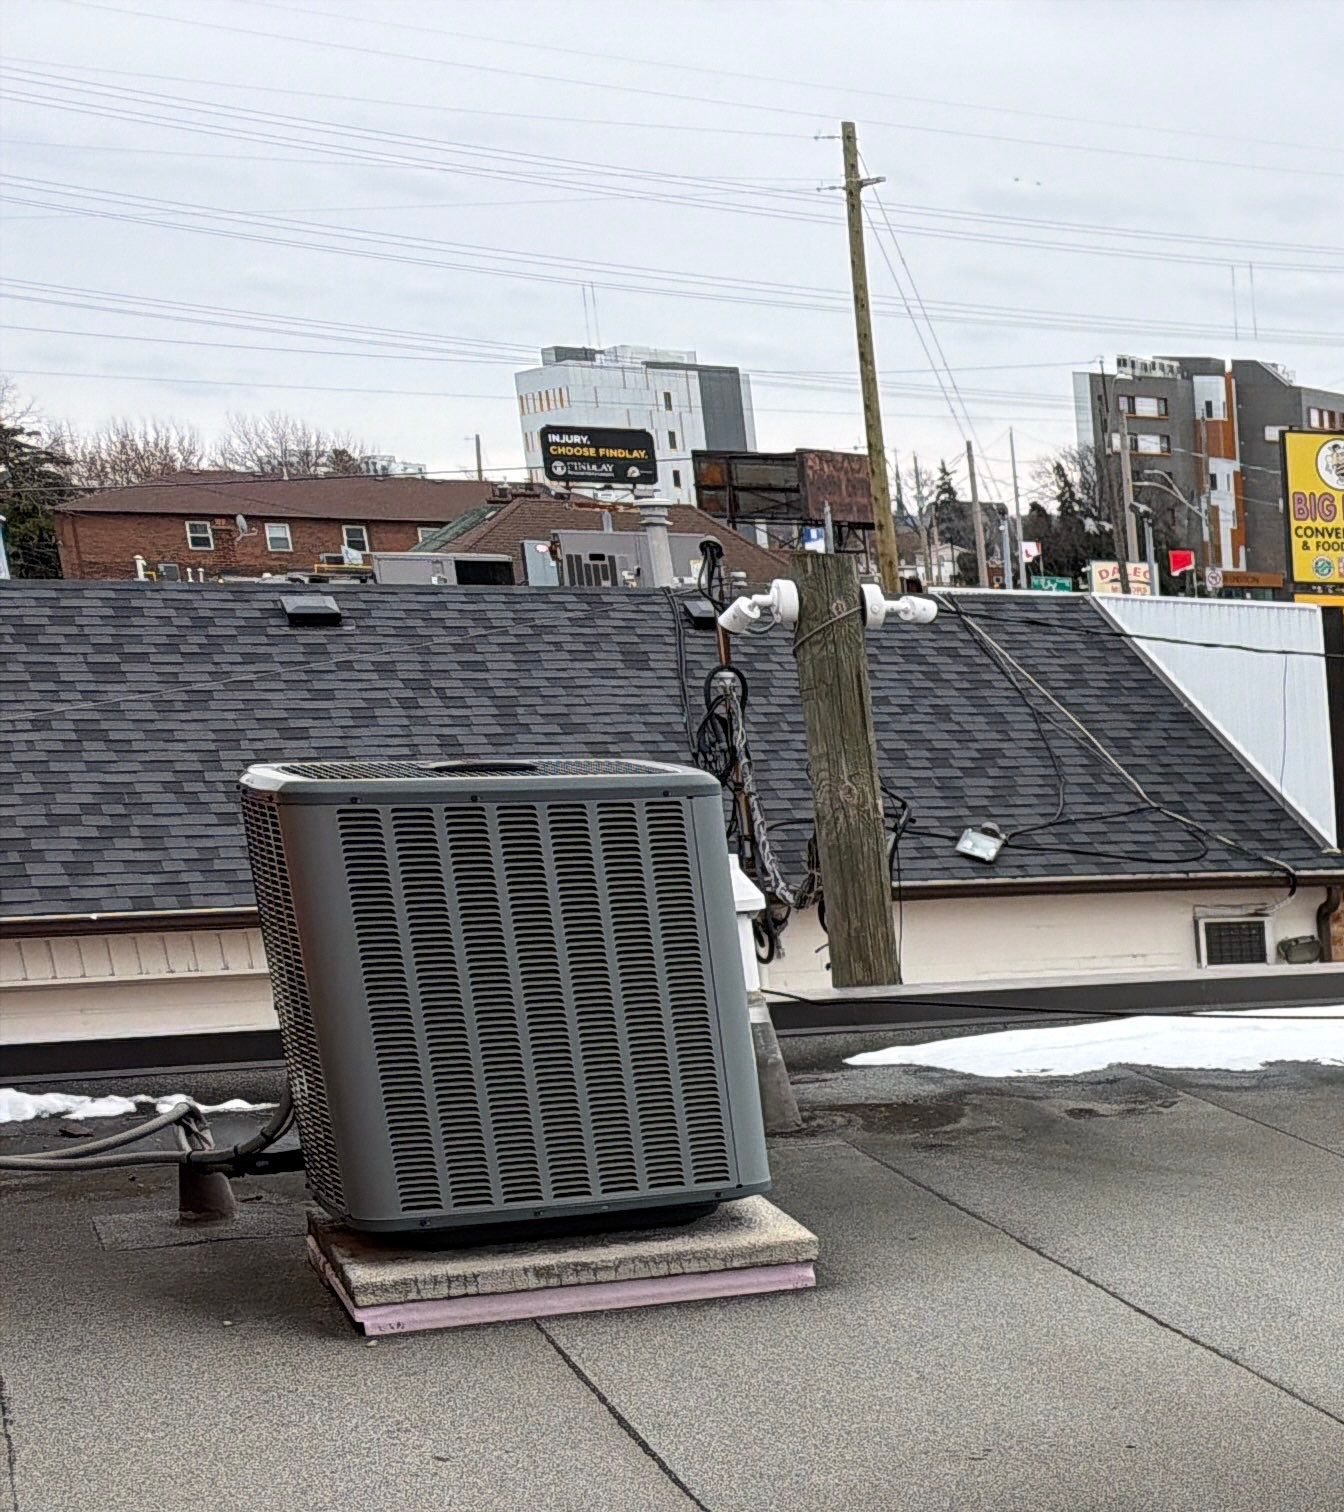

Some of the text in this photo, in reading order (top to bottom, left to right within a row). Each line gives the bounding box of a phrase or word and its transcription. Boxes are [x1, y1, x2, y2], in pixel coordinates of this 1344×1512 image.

[548, 434, 591, 445] INJURY.
[549, 446, 649, 459] CHOOSE FINDLAY.
[1292, 491, 1337, 523] BIG
[1302, 540, 1311, 551] &
